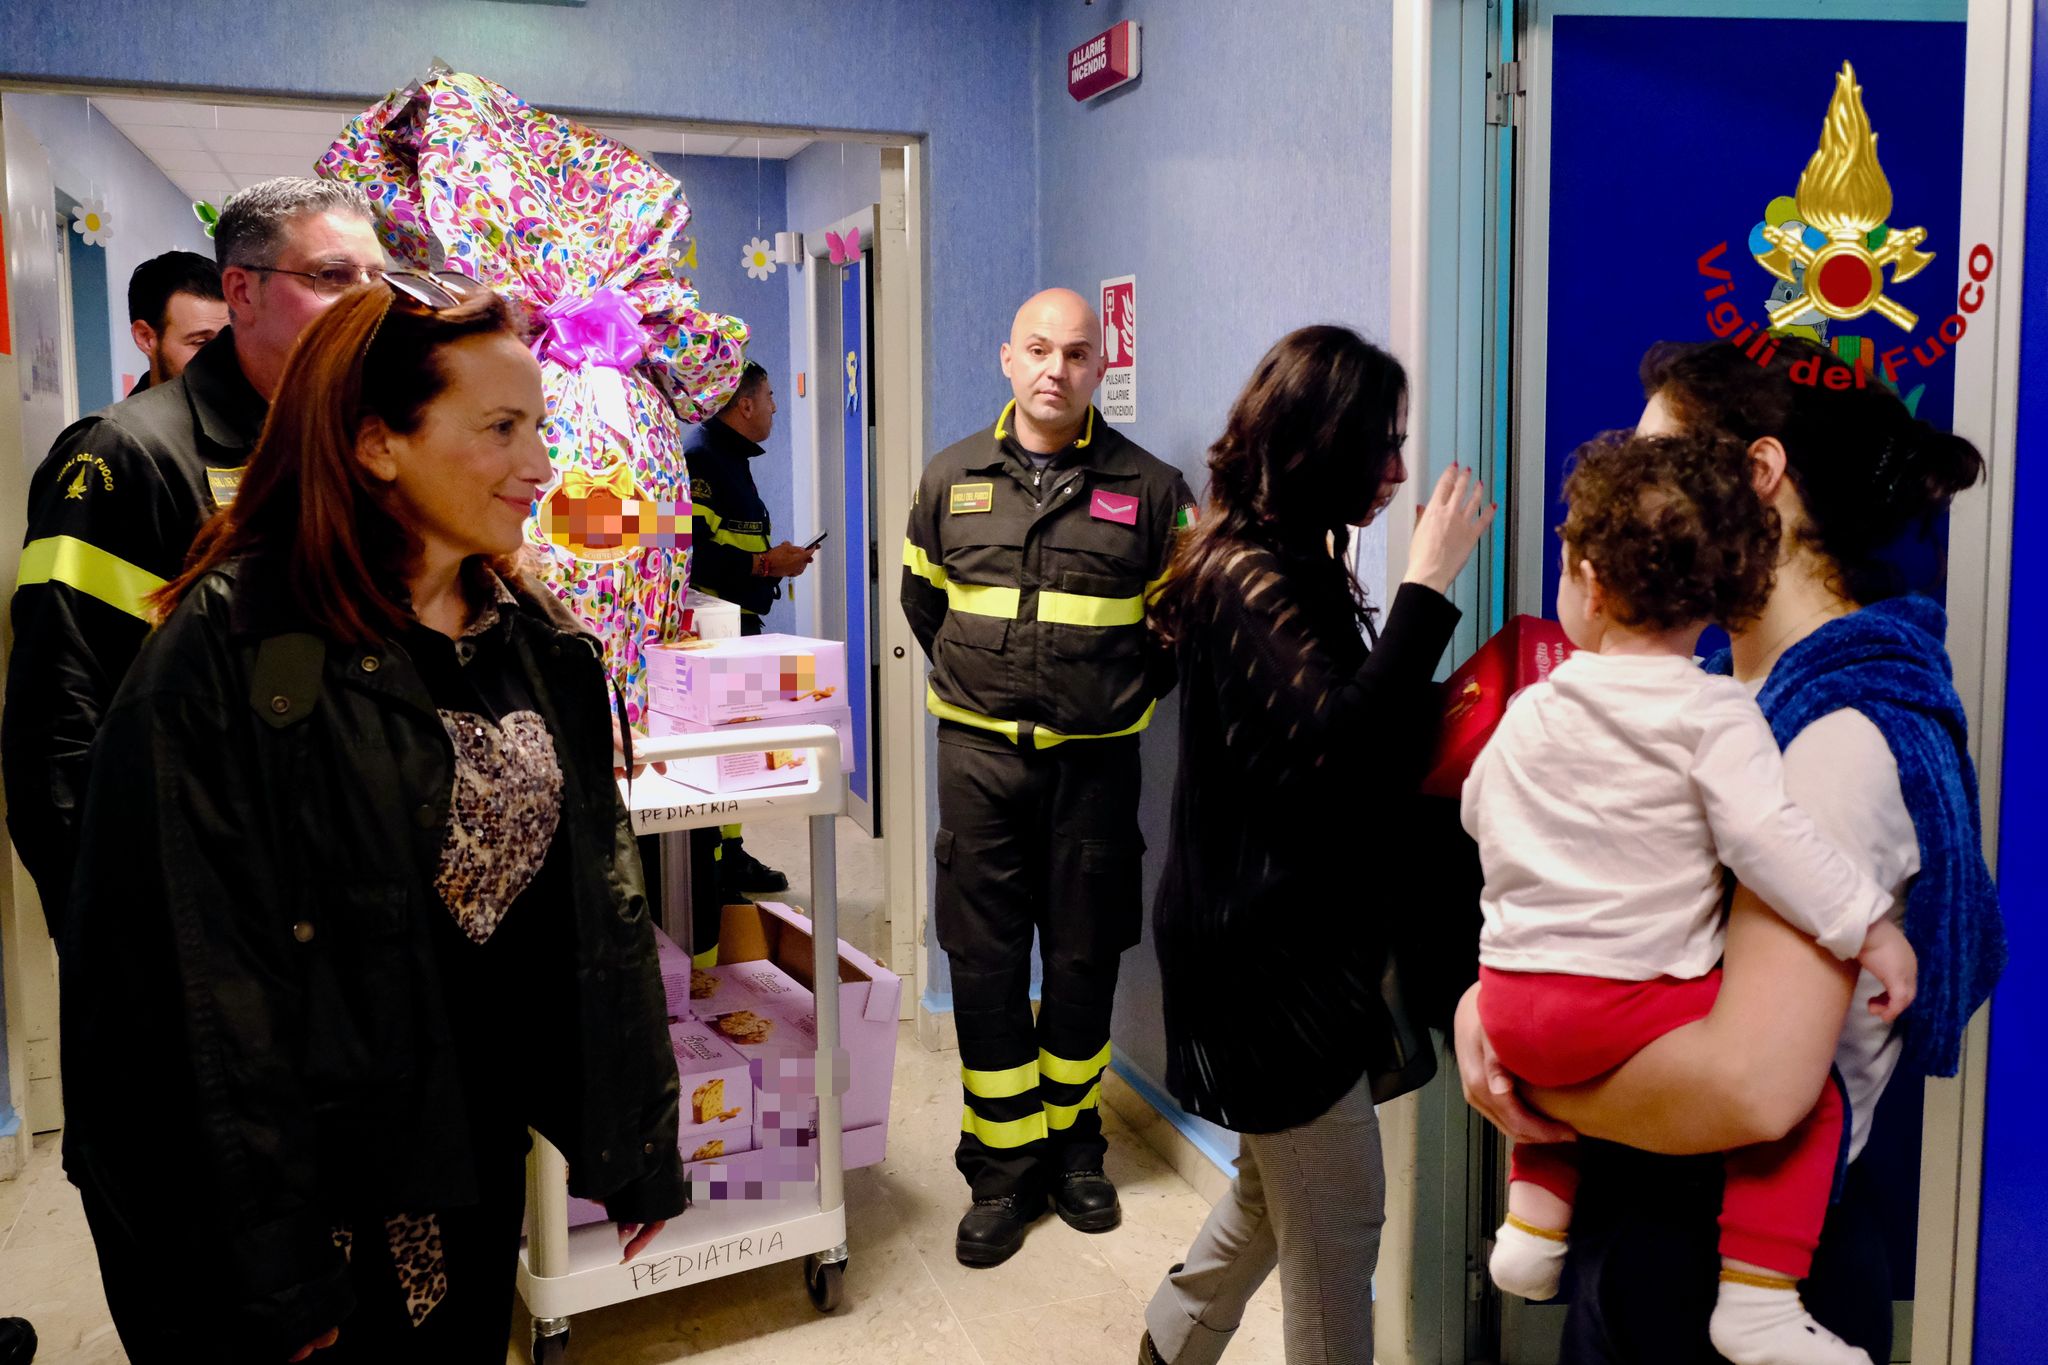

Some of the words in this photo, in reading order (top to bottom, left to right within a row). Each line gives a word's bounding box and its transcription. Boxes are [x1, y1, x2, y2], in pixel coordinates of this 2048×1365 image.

[1072, 36, 1106, 68] ALLARME
[1071, 53, 1107, 84] INCENDIO
[1106, 373, 1131, 385] PULSANTE
[1107, 389, 1130, 401] ALLARME
[1103, 405, 1133, 417] ANTINCENDIO
[76, 452, 93, 462] DEL
[94, 457, 114, 491] FUOCO
[625, 1231, 784, 1290] PEDIATRIA
